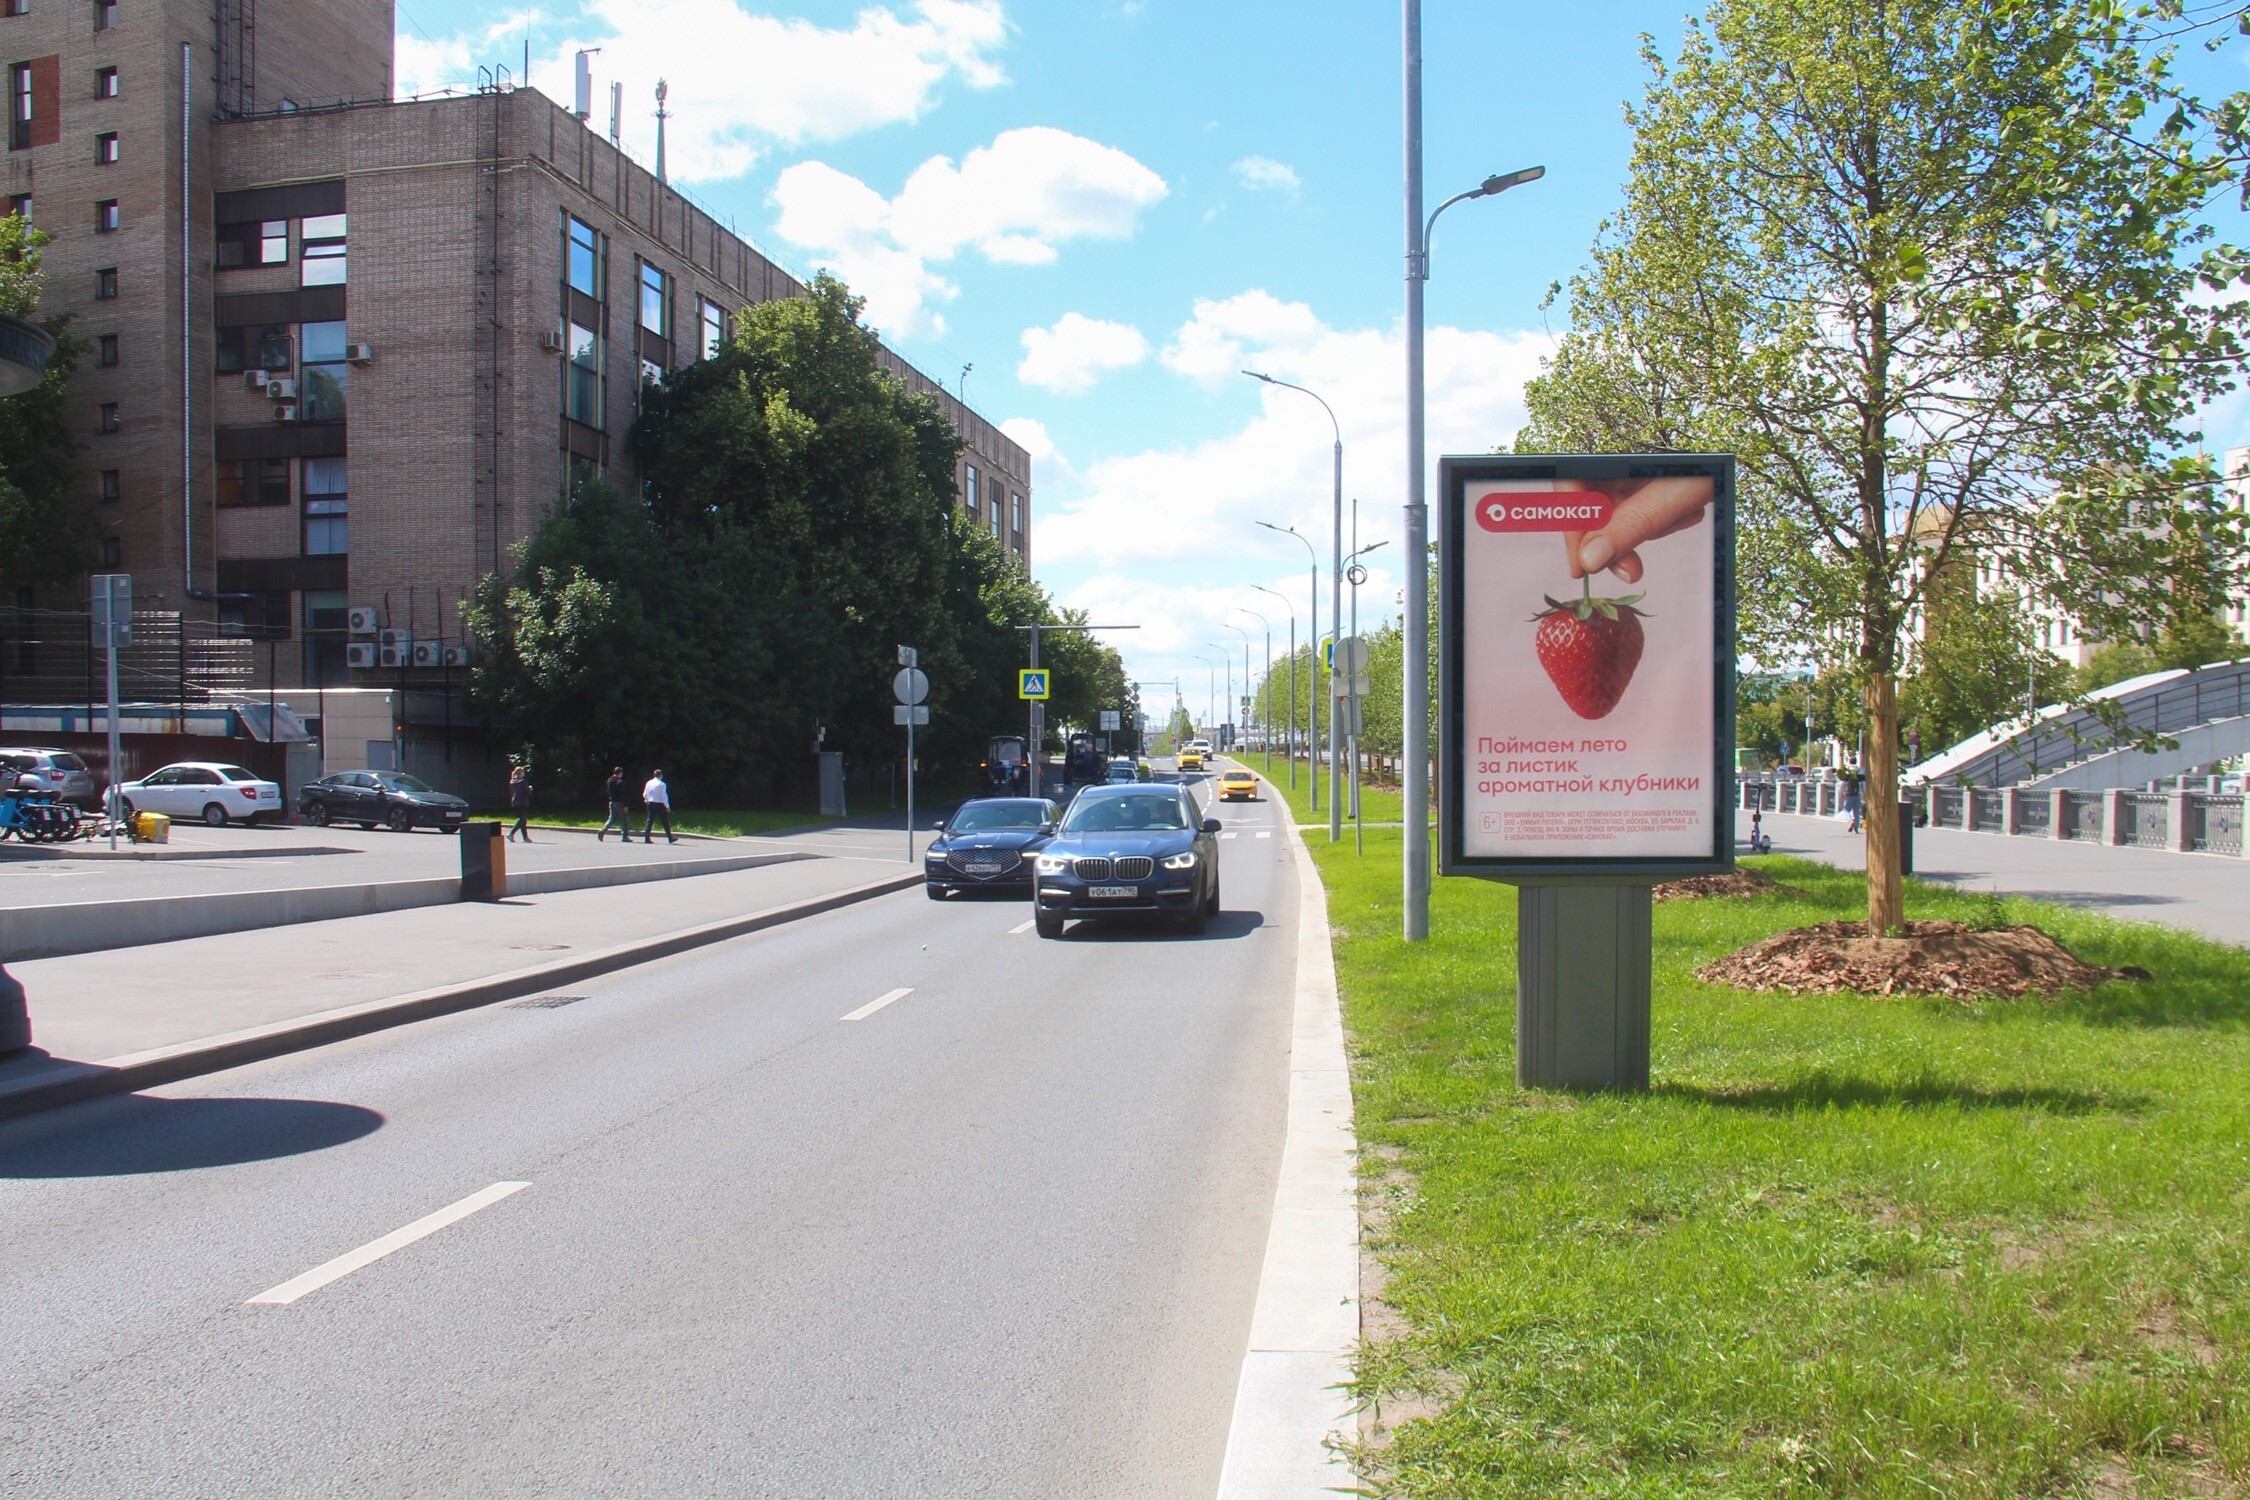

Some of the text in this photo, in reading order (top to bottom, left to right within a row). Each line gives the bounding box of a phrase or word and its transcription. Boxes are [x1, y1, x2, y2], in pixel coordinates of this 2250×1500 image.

[1511, 505, 1602, 519] самокат
[1478, 736, 1627, 754] Поймаем лето
[1478, 760, 1578, 773] за листик
[1478, 773, 1699, 797] ароматной клубники
[1483, 816, 1497, 829] 6+
